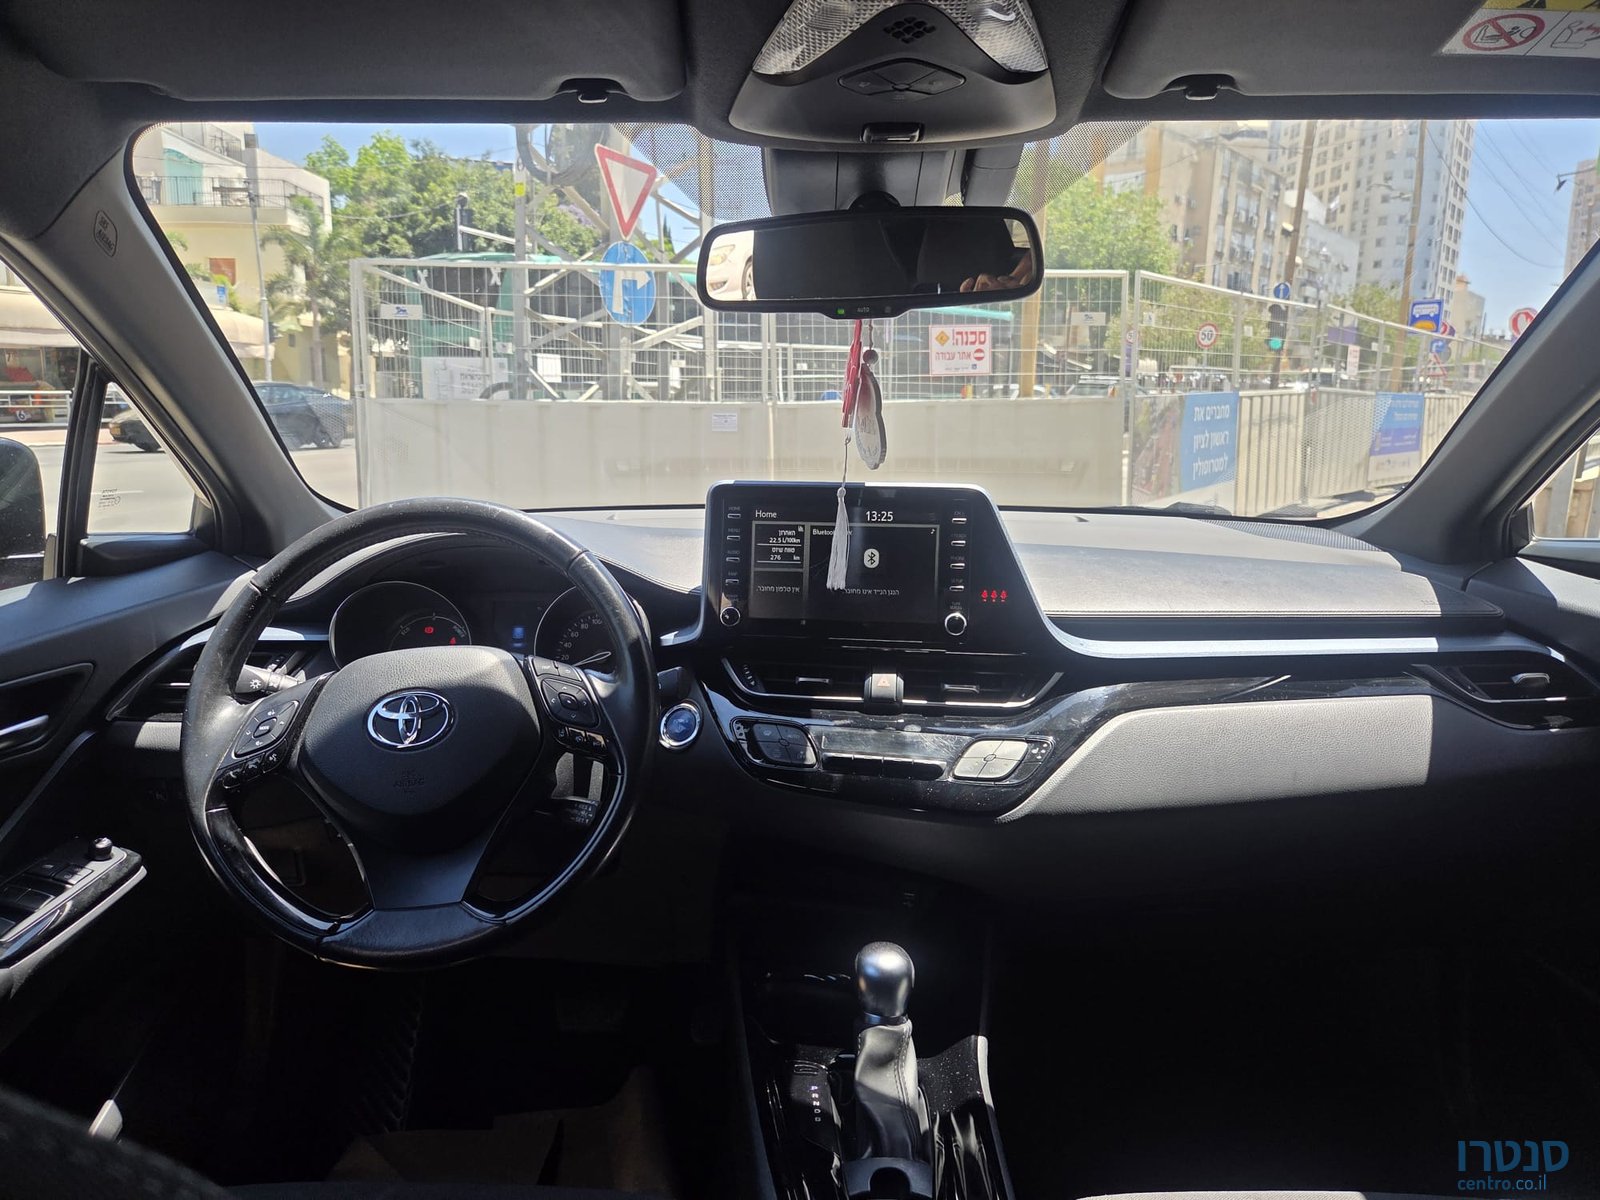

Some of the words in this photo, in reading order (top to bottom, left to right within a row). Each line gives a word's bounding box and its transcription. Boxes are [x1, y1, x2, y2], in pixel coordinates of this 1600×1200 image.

[952, 329, 987, 346] סכנה!
[1200, 330, 1214, 341] 50
[935, 351, 956, 361] עבודה
[957, 351, 972, 361] אתר
[1193, 406, 1205, 422] את
[1205, 404, 1231, 421] מחברים
[1193, 429, 1210, 454] לציון
[1210, 430, 1230, 450] ראשון
[755, 509, 778, 519] Home
[865, 511, 894, 522] 13:25
[563, 641, 573, 649] 40
